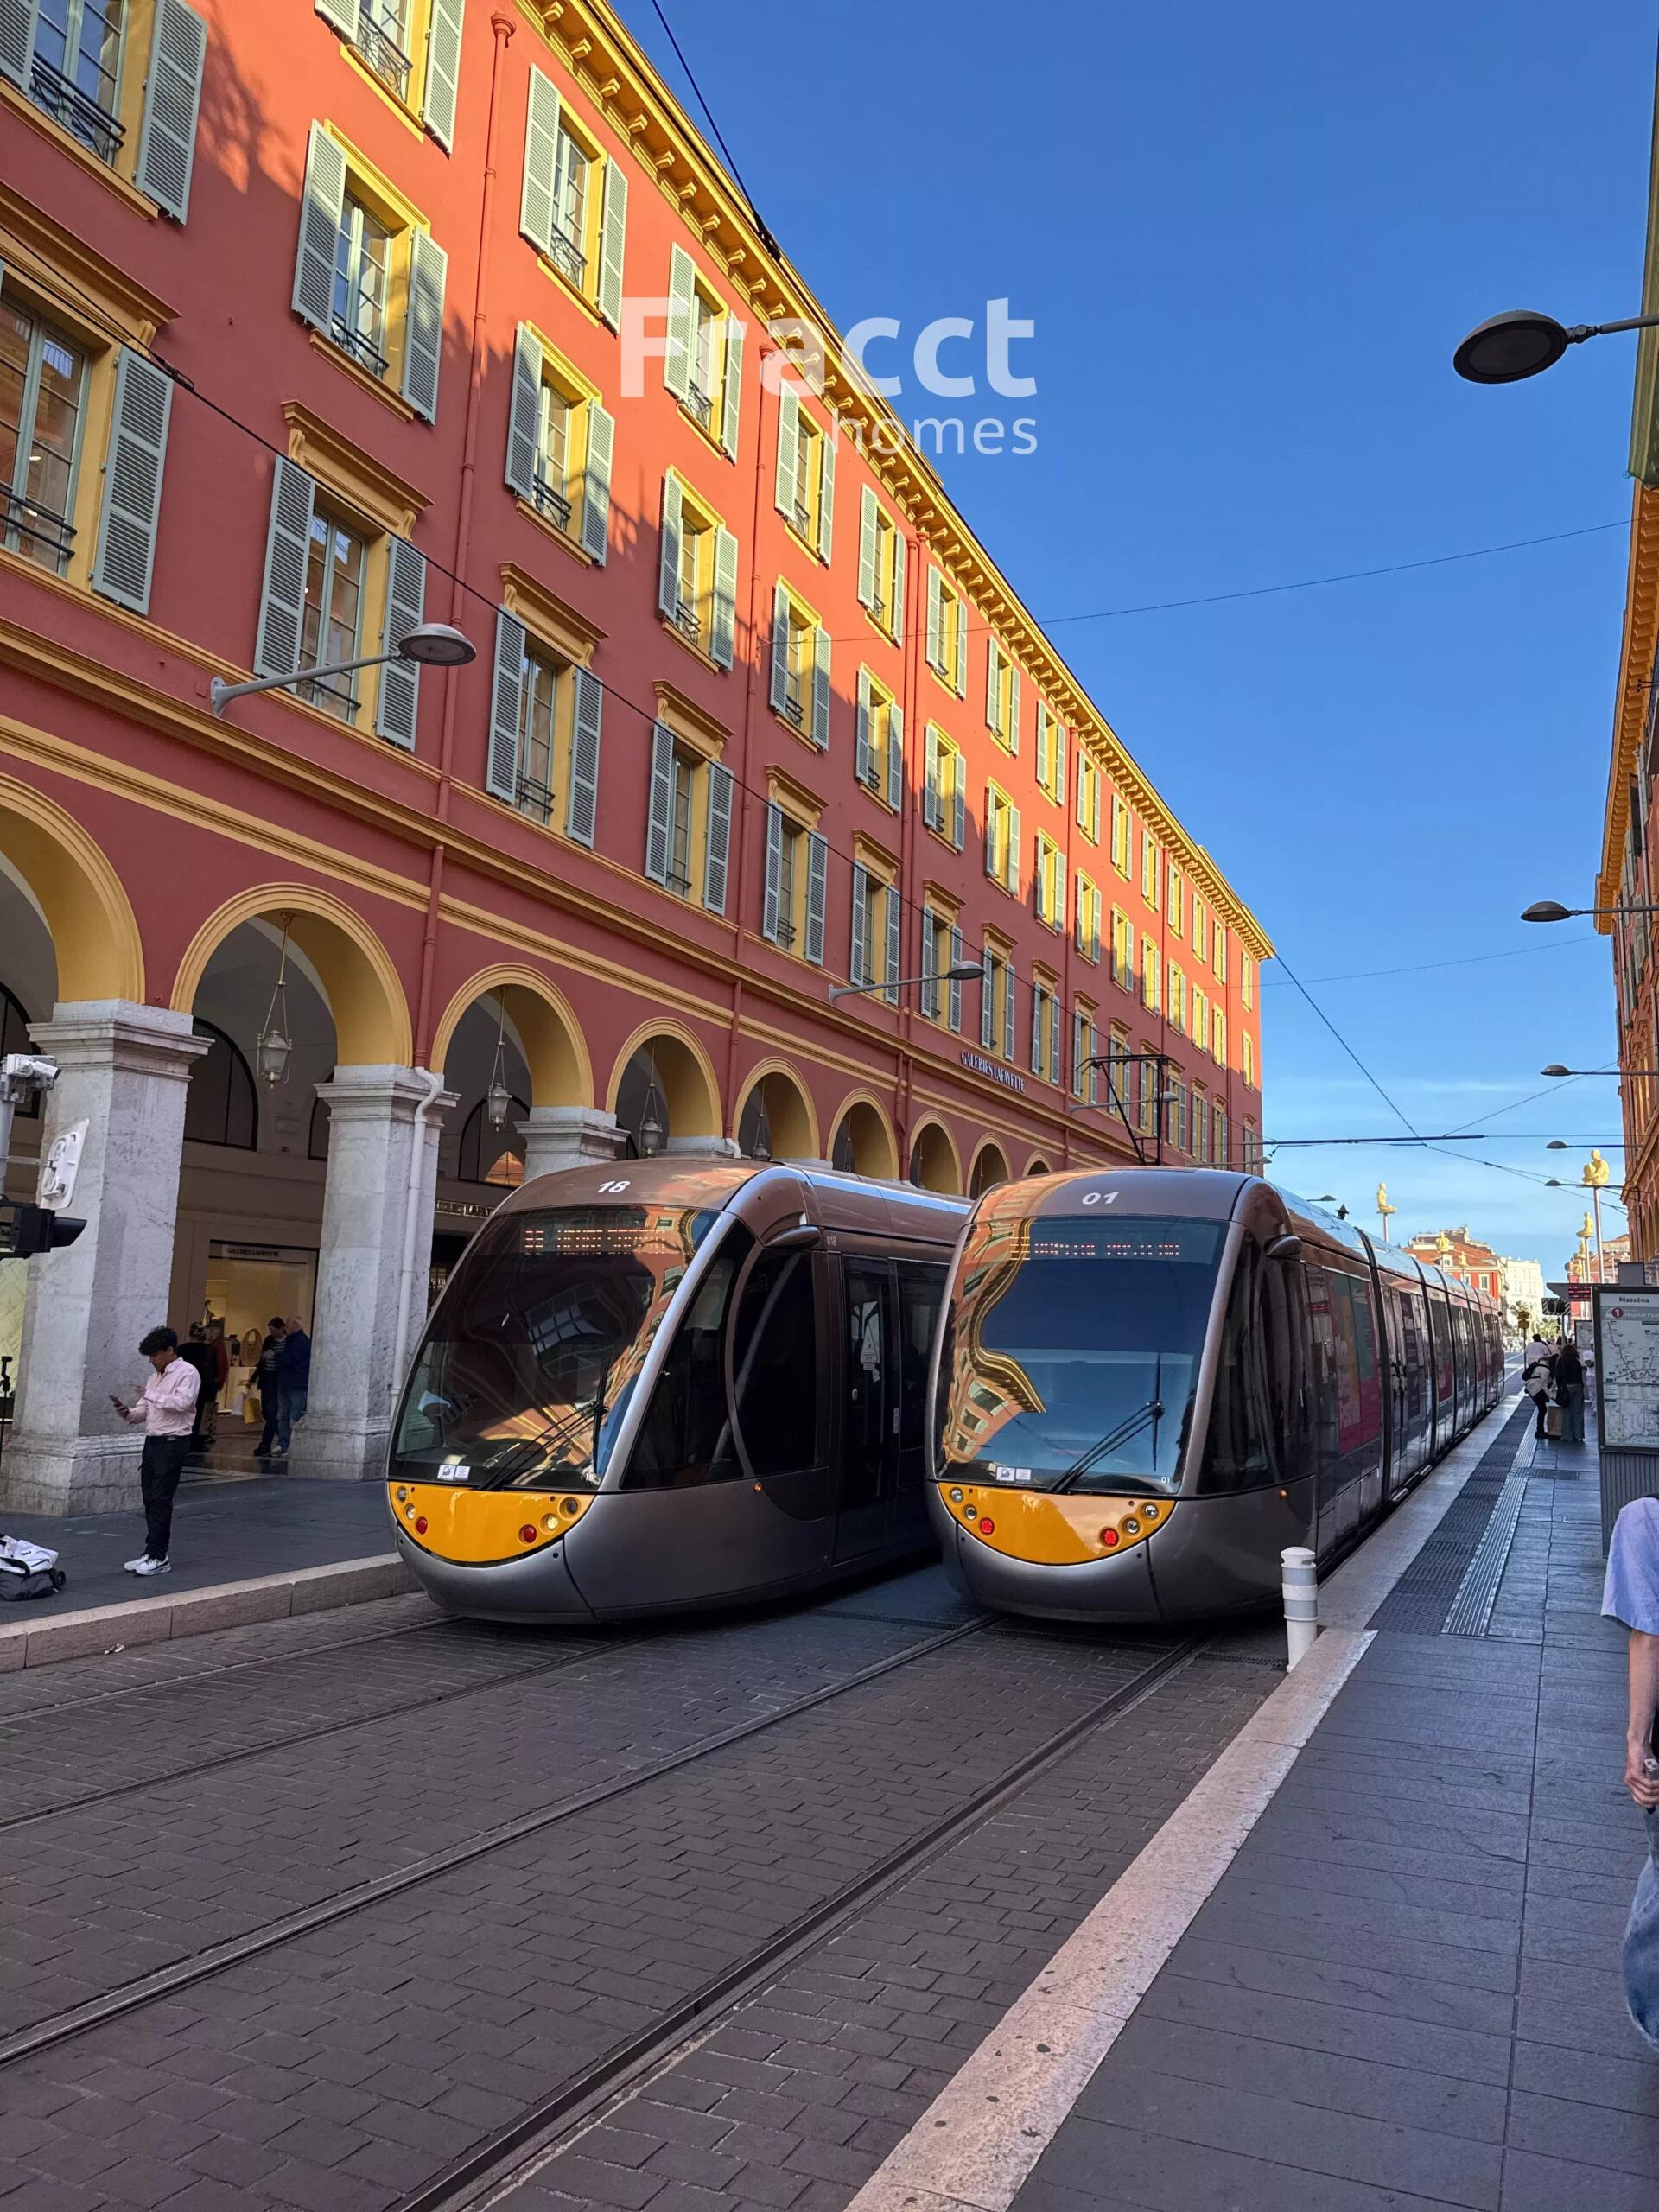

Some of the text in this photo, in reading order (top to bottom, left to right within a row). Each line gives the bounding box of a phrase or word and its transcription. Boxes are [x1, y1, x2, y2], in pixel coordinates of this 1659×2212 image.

[961, 1050, 1025, 1092] GALERIES LAFAYETTE
[597, 1180, 630, 1193] 18
[1082, 1192, 1119, 1205] 01
